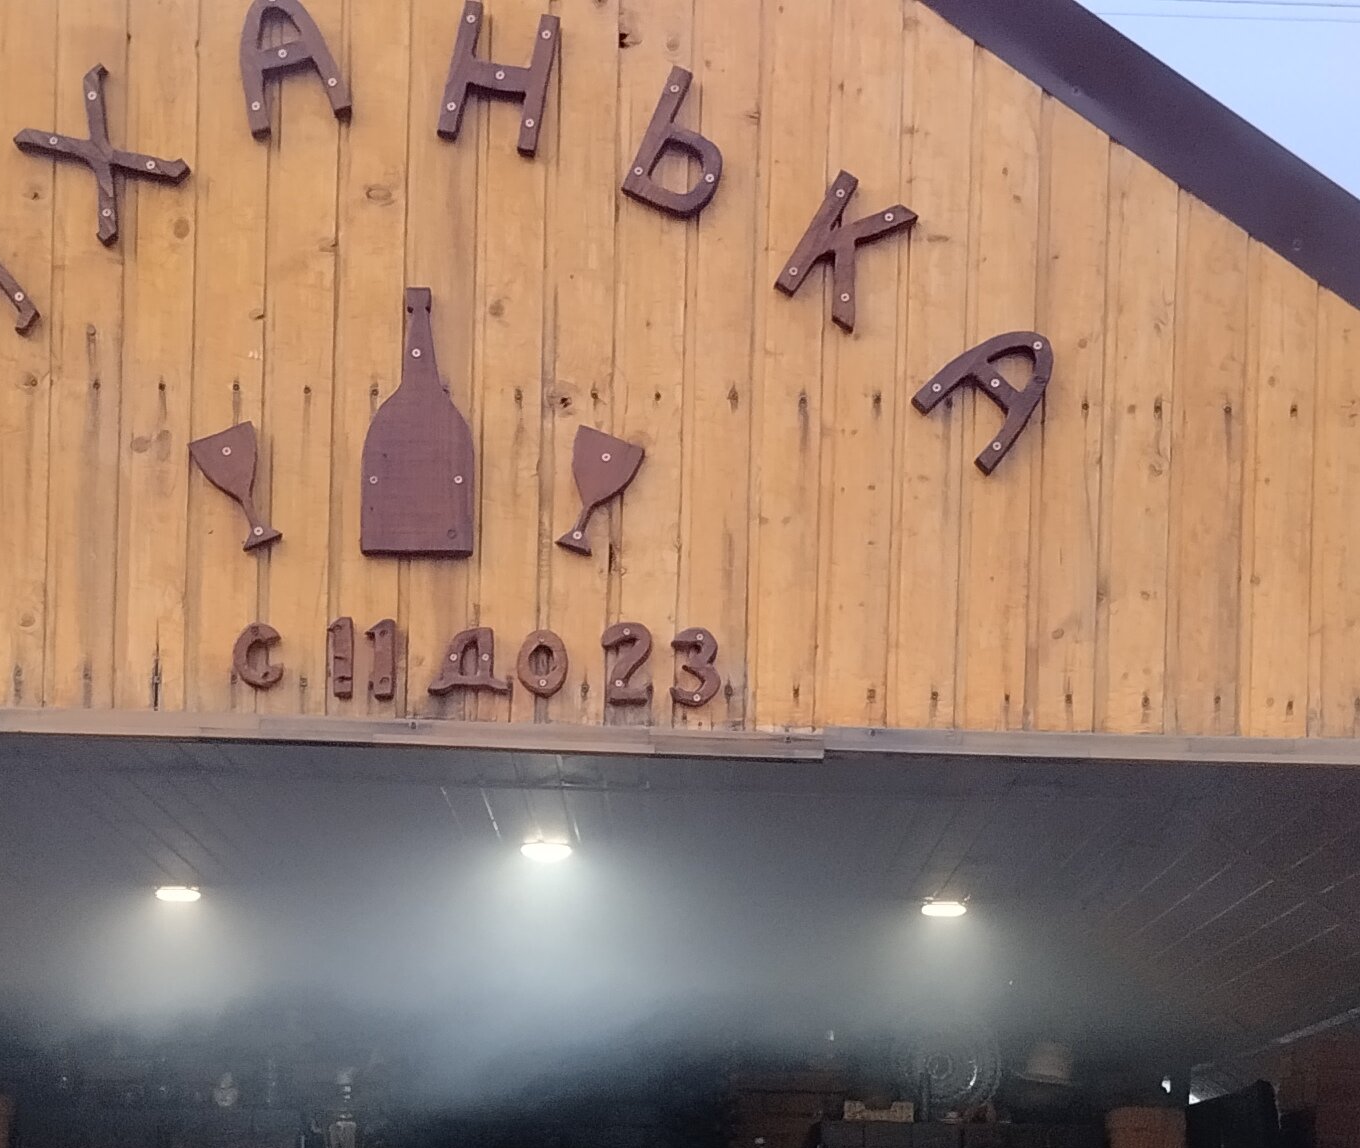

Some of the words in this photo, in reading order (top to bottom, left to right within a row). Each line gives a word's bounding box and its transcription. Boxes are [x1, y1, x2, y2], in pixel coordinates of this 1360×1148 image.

[326, 617, 396, 700] 11
[428, 627, 568, 697] ДО
[601, 622, 722, 707] 23
